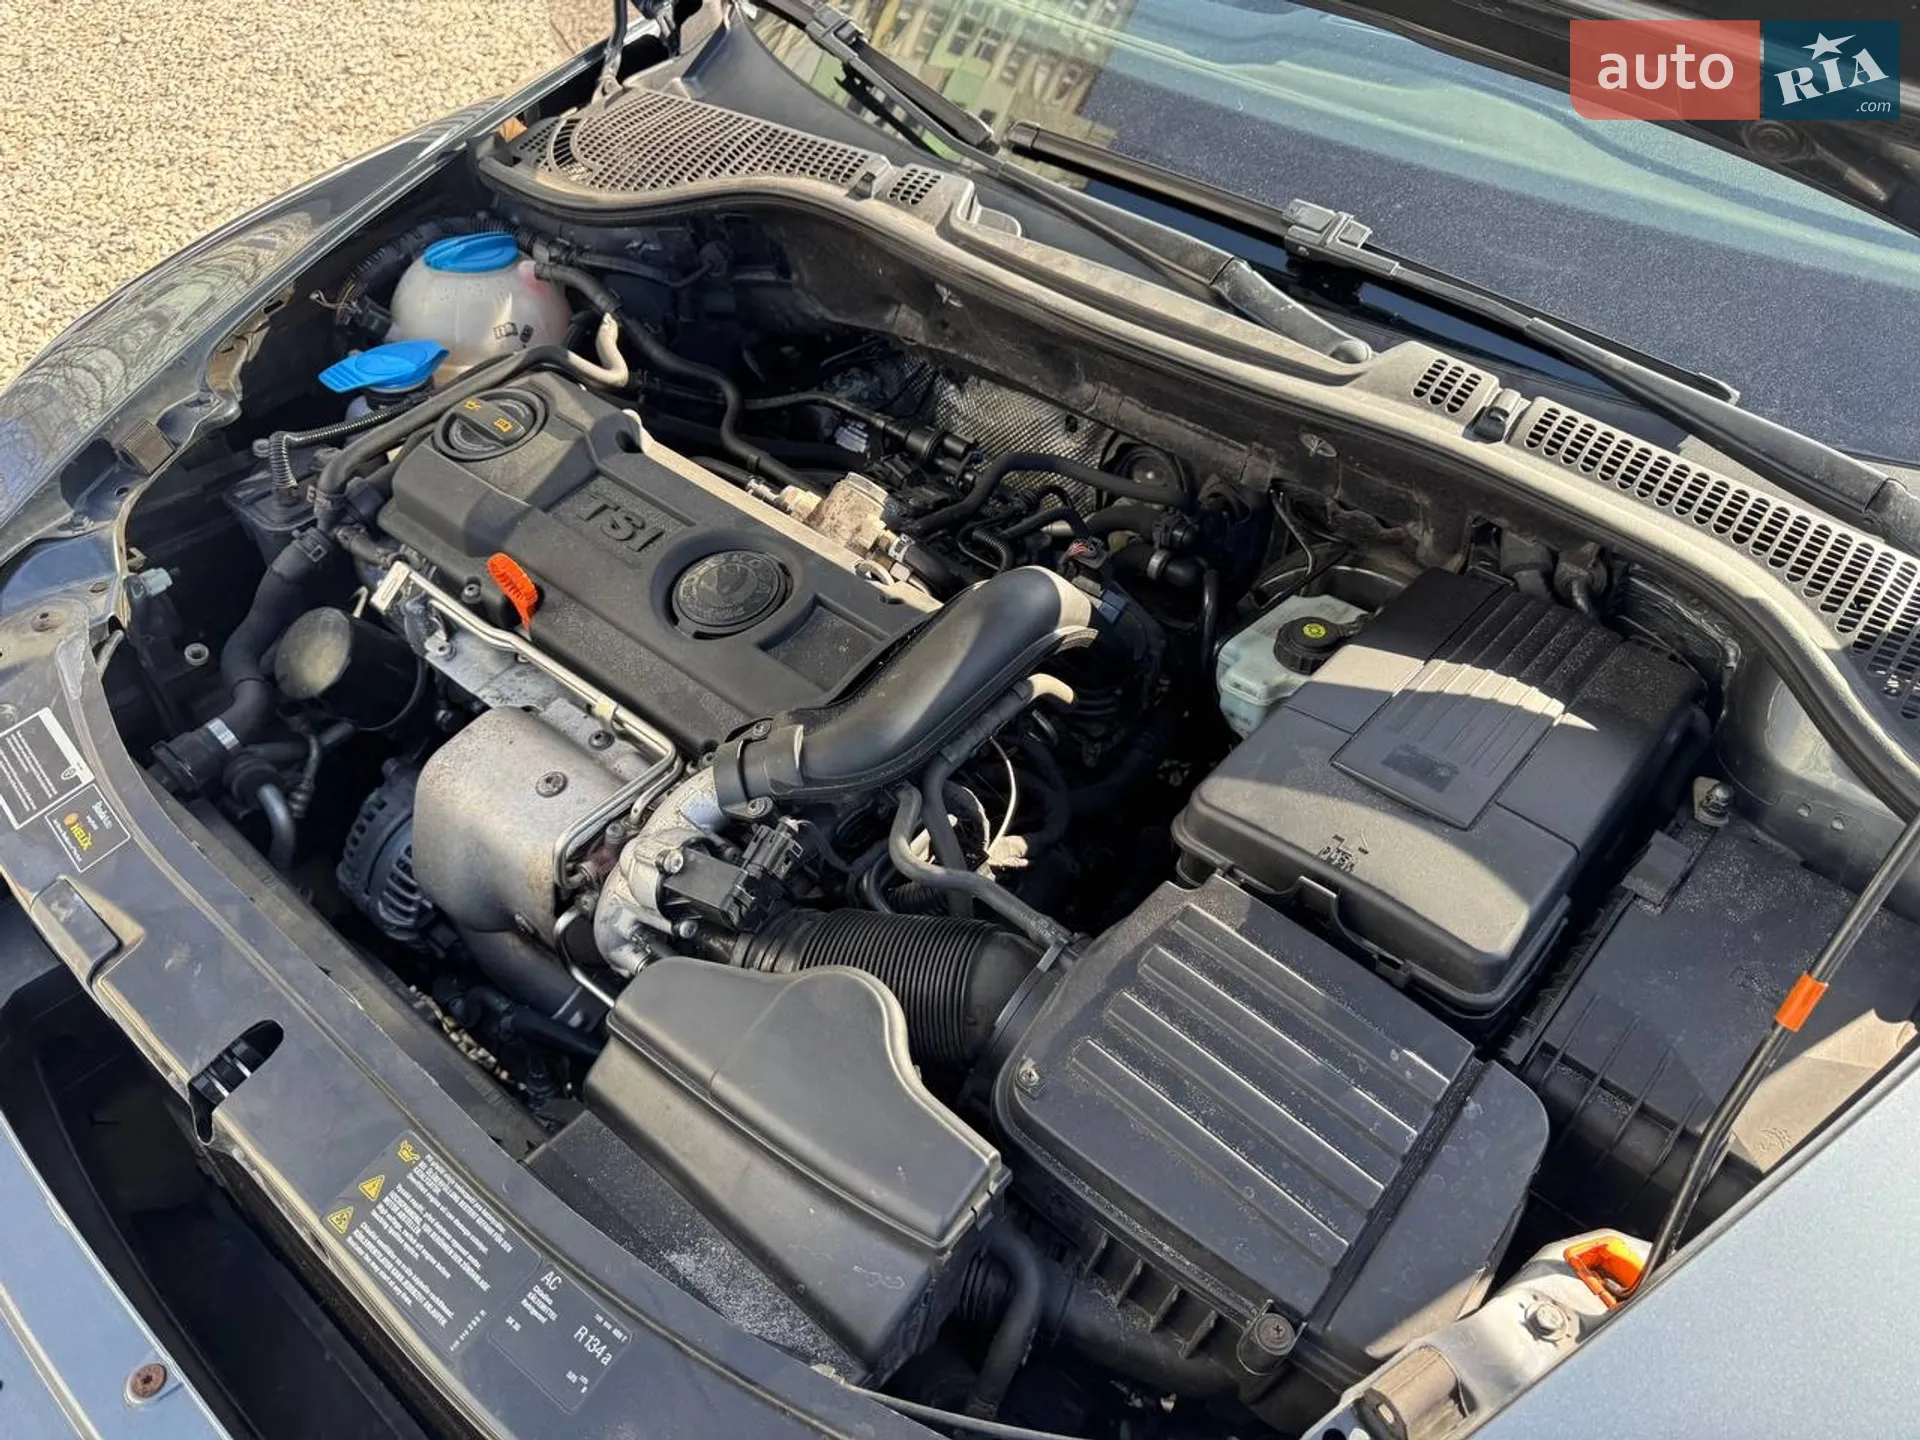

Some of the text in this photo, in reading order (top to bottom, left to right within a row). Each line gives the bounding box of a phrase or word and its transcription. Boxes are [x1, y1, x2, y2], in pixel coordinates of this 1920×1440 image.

[575, 493, 665, 554] TSI
[70, 822, 93, 851] HELIX
[540, 1269, 562, 1291] AC
[573, 1324, 589, 1342] R
[582, 1332, 607, 1358] 134
